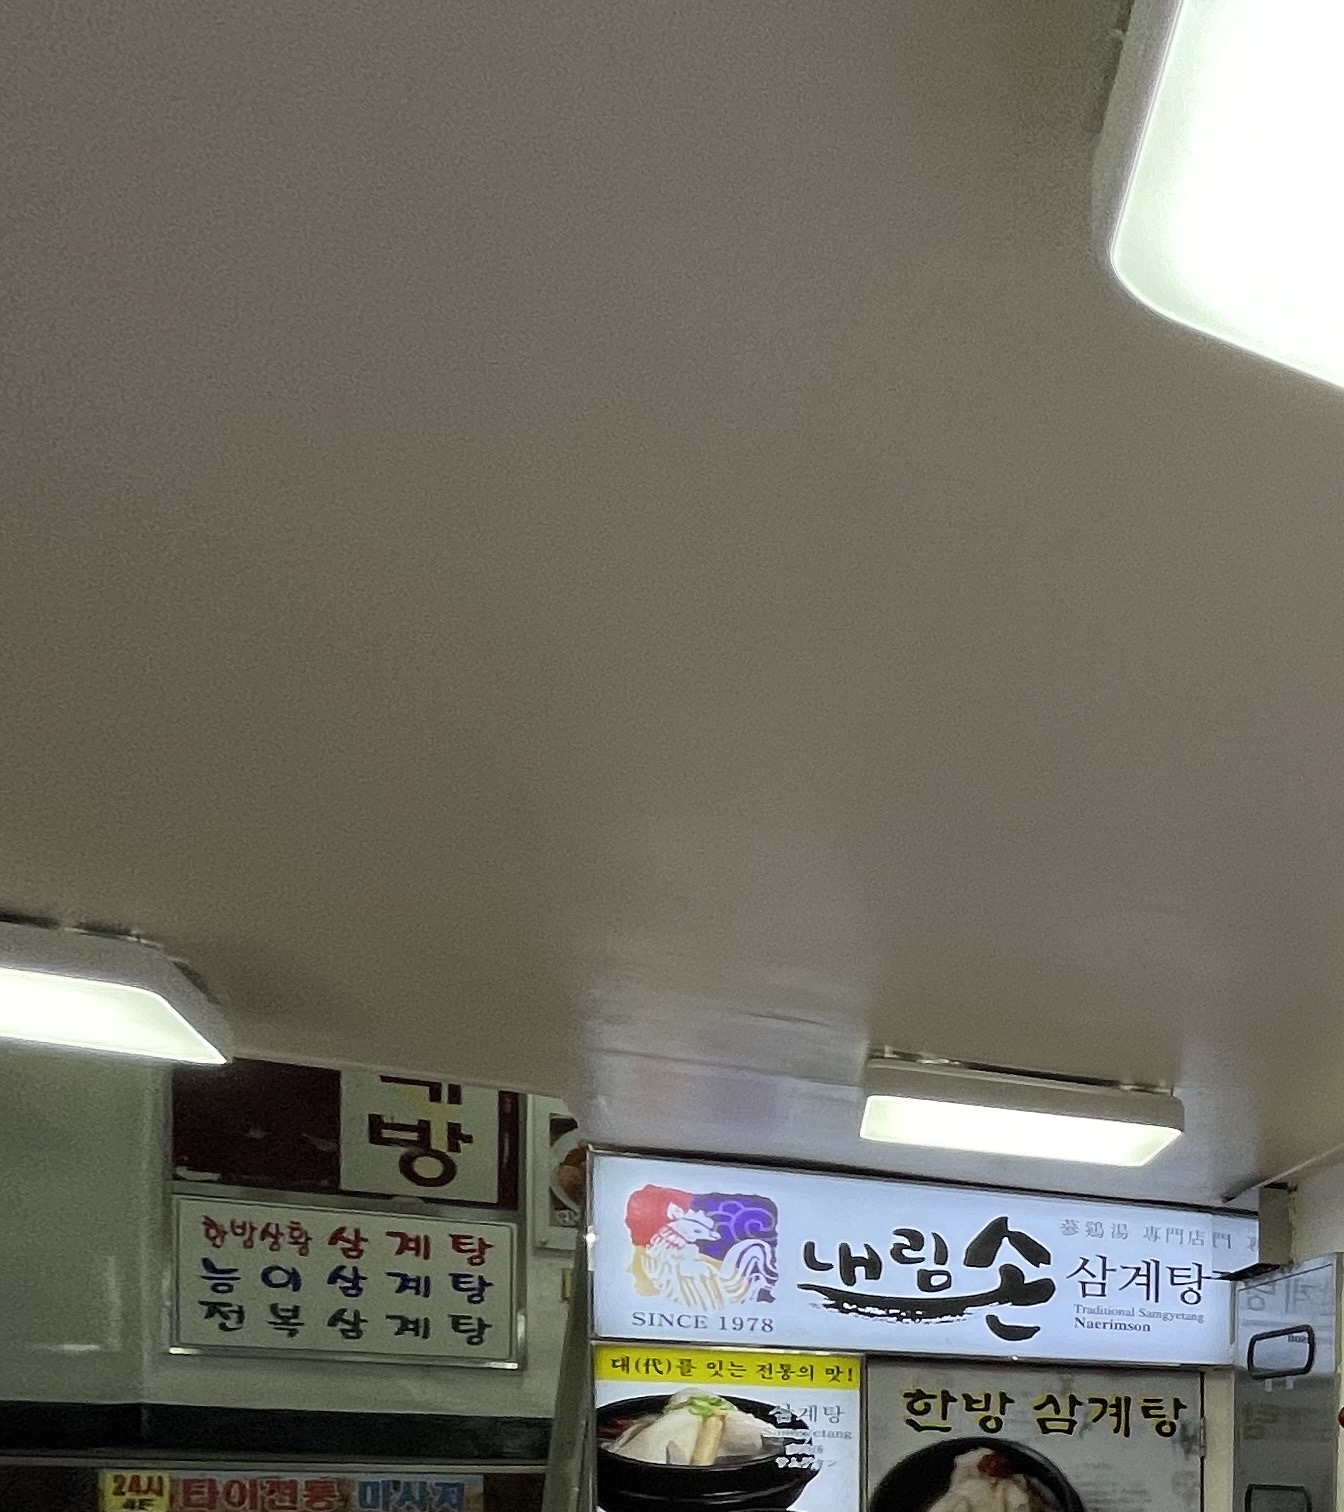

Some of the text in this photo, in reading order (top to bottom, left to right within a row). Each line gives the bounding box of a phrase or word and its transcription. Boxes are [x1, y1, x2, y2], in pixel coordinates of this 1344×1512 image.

[328, 1226, 494, 1267] 삼계탕
[797, 1215, 1057, 1342] 내림손
[1066, 1254, 1212, 1305] 삼계탕
[631, 1310, 775, 1334] SINCE 1978
[1074, 1317, 1151, 1332] Naerimson
[756, 1363, 815, 1382] 전통의
[824, 1365, 854, 1383] 맛!
[903, 1388, 1188, 1438] 한방 삼계탕
